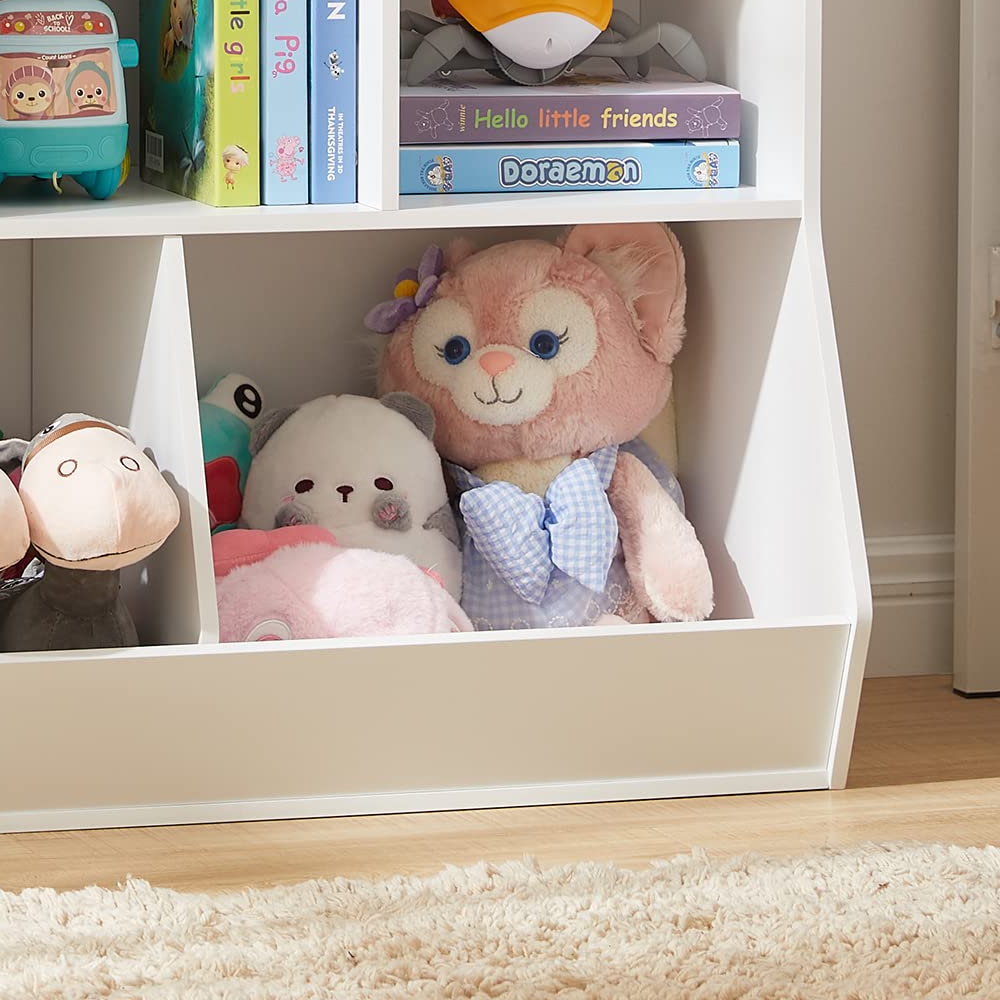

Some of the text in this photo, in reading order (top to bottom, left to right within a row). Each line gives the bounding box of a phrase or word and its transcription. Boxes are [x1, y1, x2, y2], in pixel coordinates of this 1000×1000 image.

[47, 13, 64, 22] BACK
[224, 42, 250, 94] girls
[272, 35, 300, 78] Pig
[458, 104, 466, 132] winnie
[474, 108, 678, 129] Hello little friends
[328, 106, 336, 181] THANKSGIVING
[338, 156, 344, 164] IN
[499, 156, 642, 186] Doraemon
